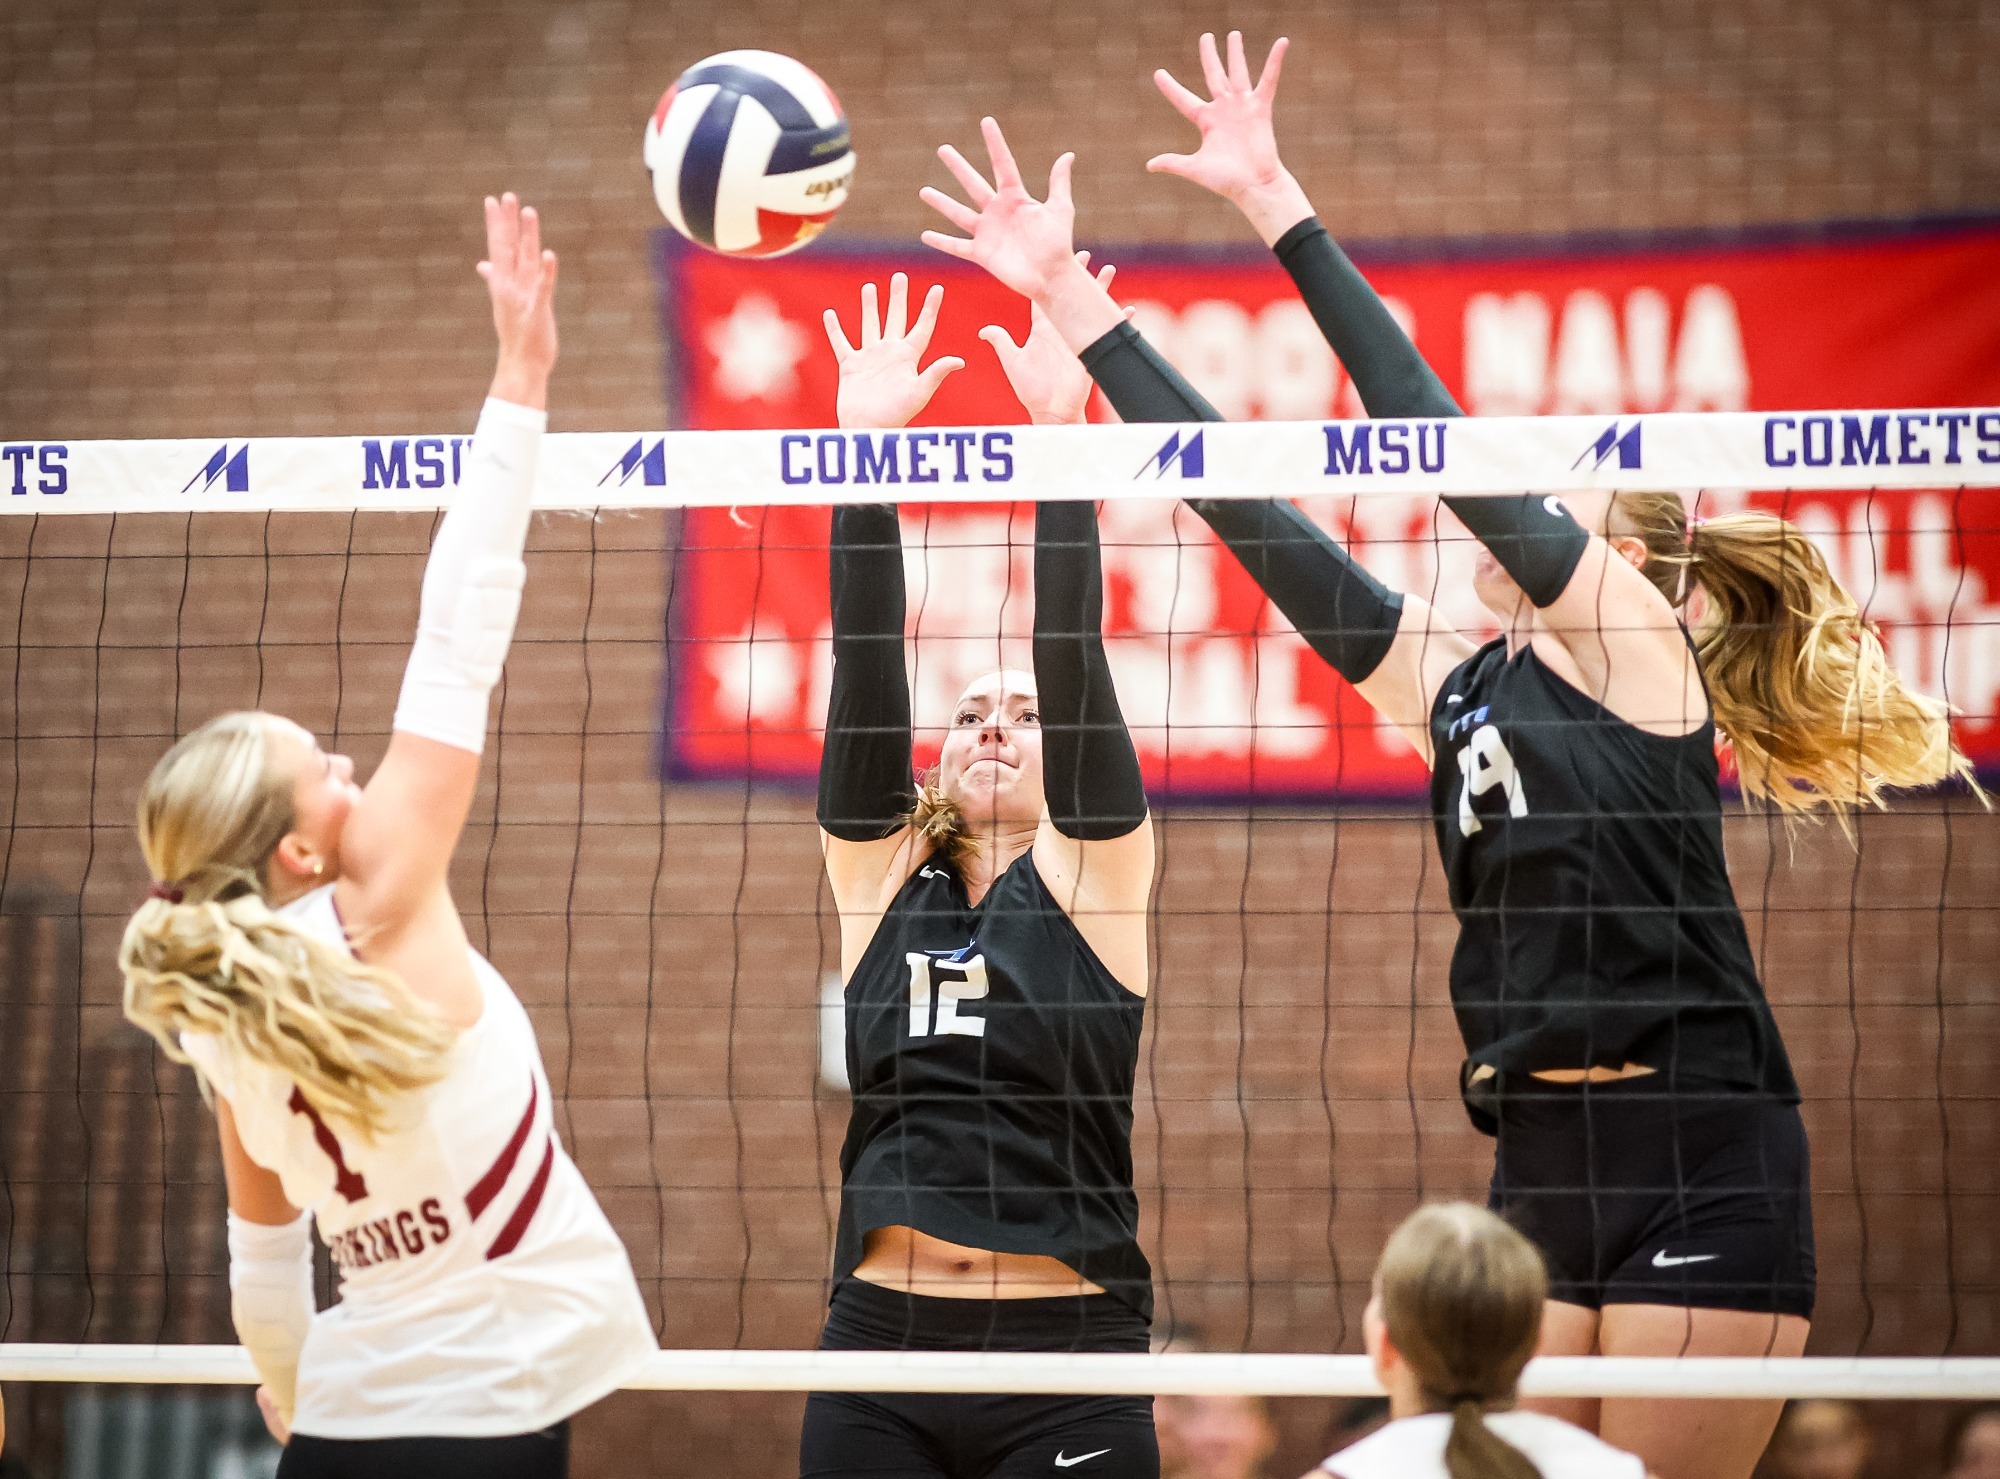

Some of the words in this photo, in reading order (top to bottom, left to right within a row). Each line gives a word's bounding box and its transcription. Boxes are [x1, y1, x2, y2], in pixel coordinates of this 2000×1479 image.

[780, 432, 1014, 485] COMETS
[1322, 424, 1447, 475] MSU
[1764, 412, 2000, 468] COMETS
[905, 951, 989, 1038] 12
[288, 1084, 369, 1204] 1
[330, 1198, 450, 1269] KINGS
